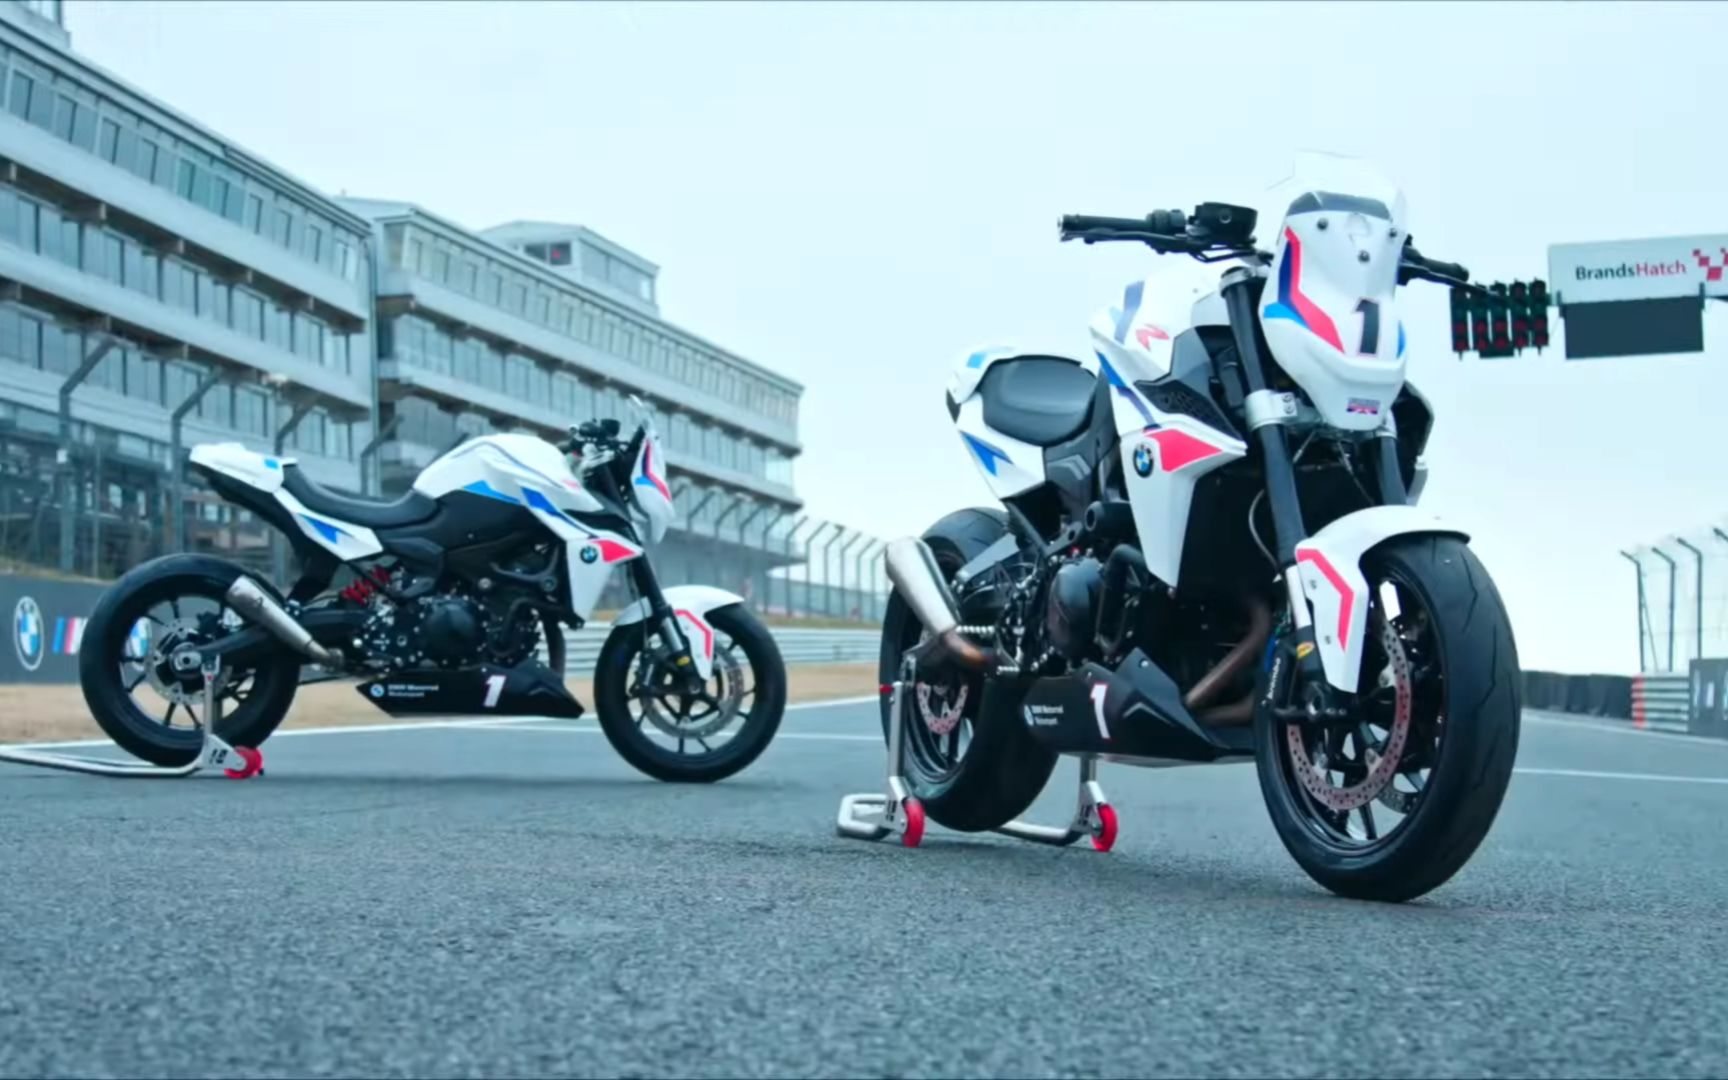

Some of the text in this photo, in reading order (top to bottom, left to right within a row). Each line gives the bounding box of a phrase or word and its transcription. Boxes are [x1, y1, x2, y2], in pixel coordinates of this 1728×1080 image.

[1575, 260, 1686, 281] BrandsHatch
[1354, 299, 1379, 354] 1
[484, 675, 507, 707] 1
[1090, 683, 1111, 740] 1
